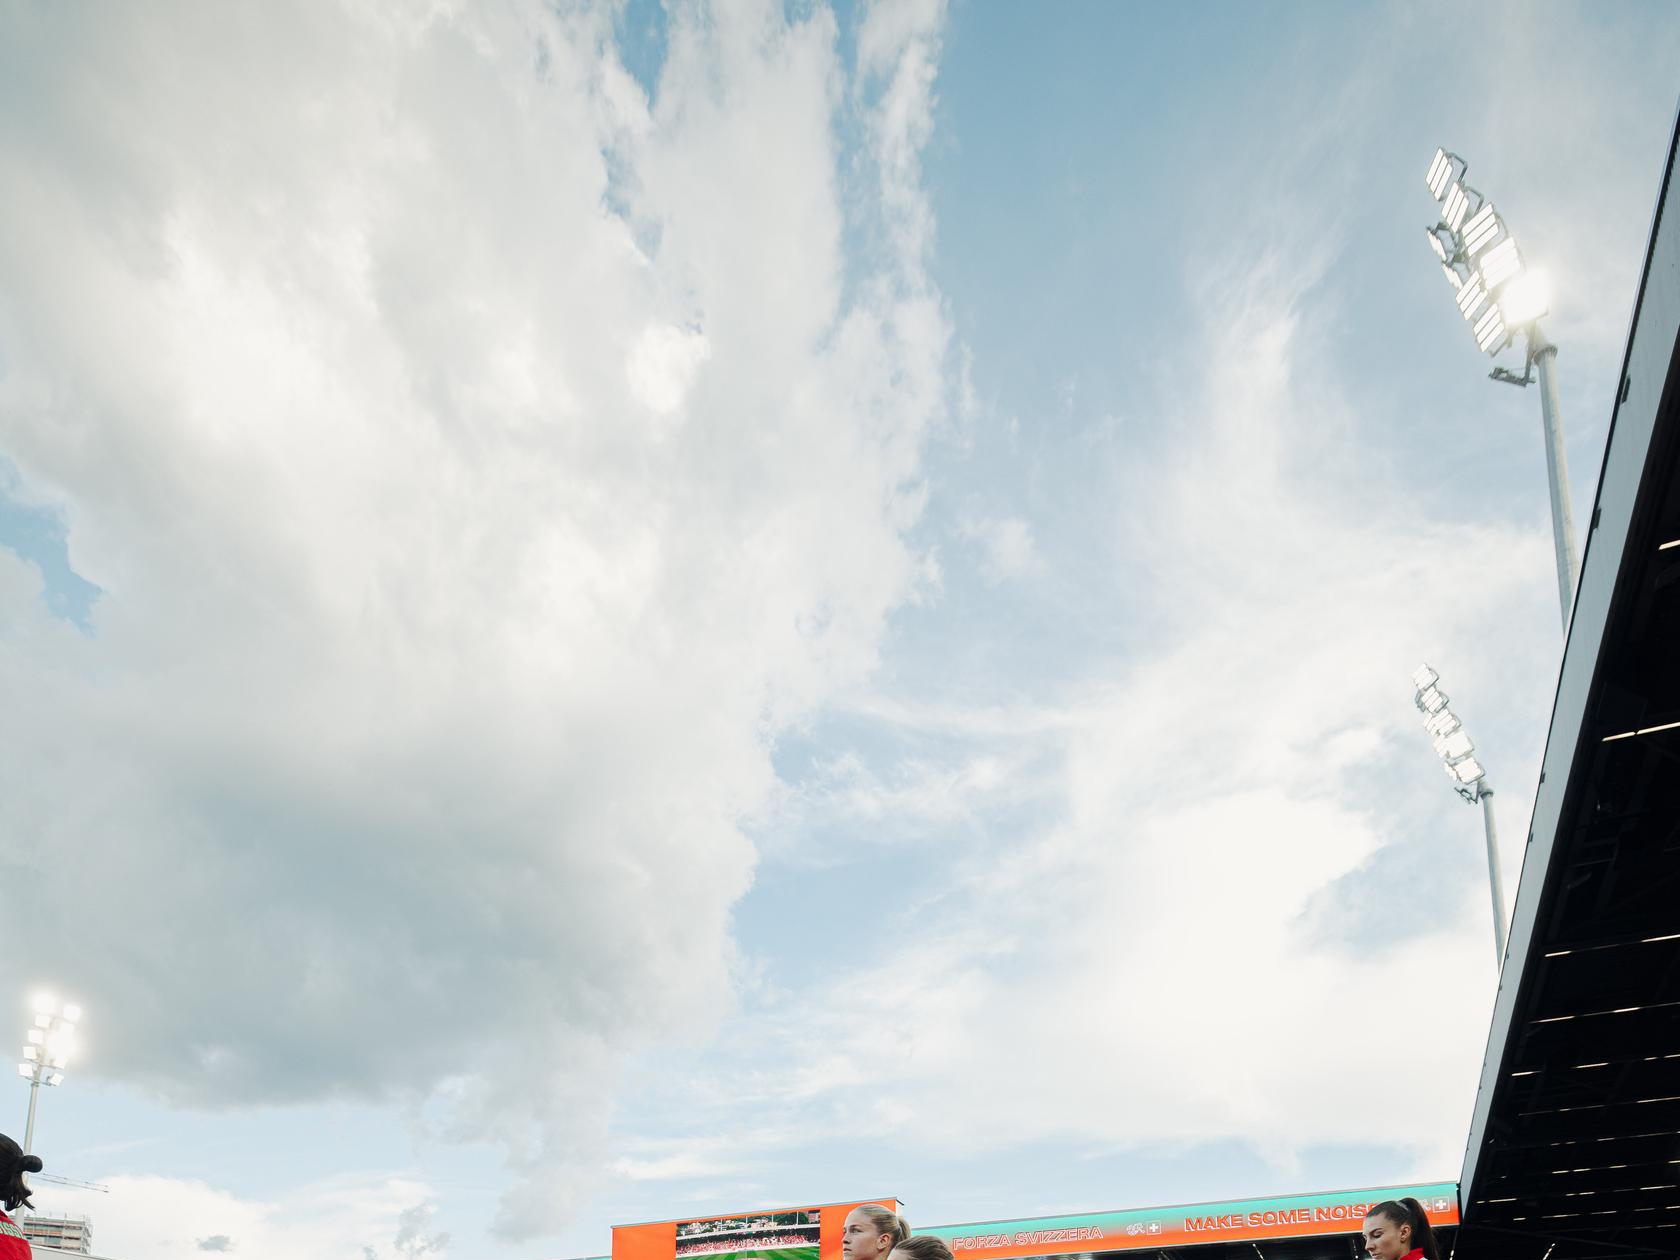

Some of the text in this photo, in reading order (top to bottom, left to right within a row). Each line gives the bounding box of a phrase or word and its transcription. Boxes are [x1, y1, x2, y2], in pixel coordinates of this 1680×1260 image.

[1184, 1213, 1242, 1232] MAKE
[1247, 1208, 1310, 1227] SOME
[952, 1226, 1104, 1250] FORZA SVIZZERA
